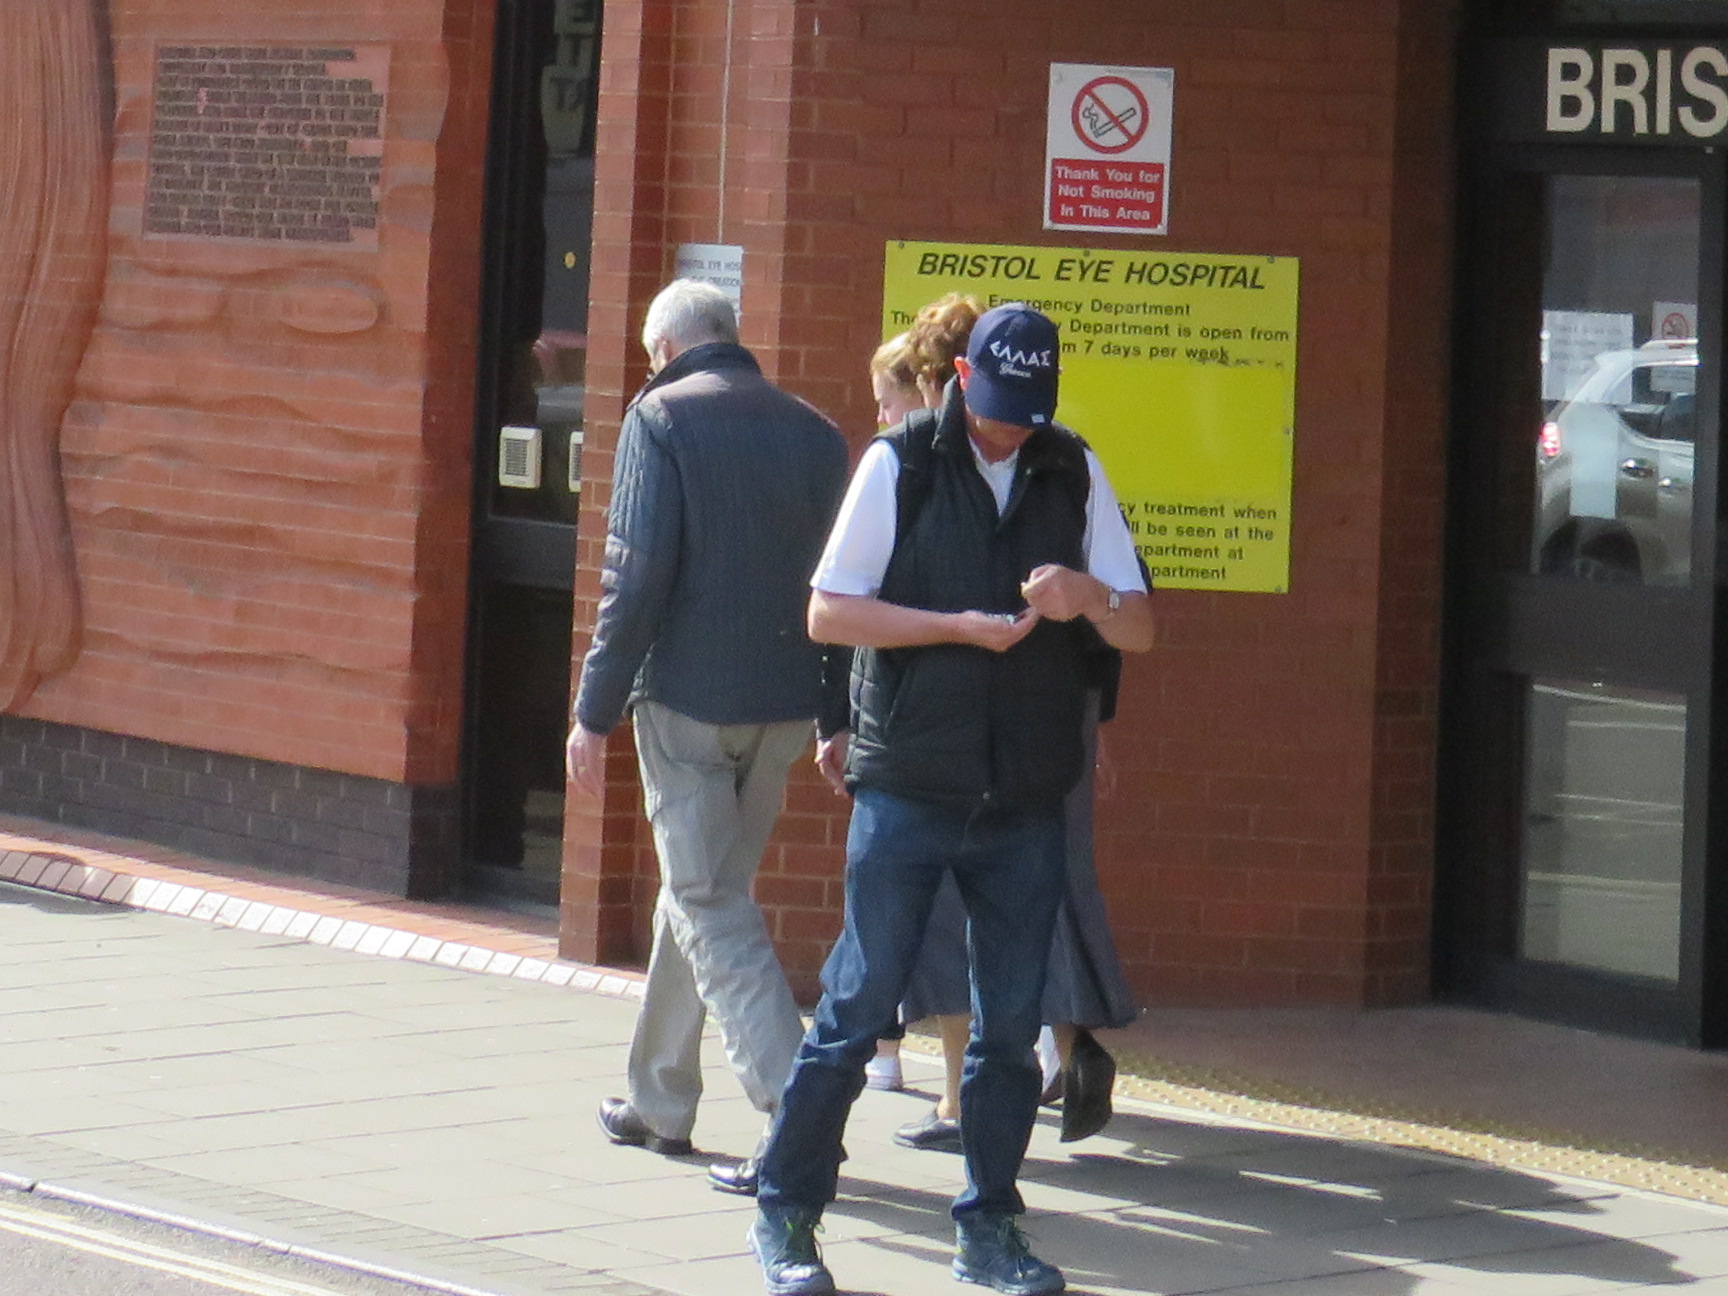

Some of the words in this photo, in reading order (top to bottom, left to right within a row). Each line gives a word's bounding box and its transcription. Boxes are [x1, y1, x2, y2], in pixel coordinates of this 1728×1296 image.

[1055, 166, 1099, 181] Thank
[1106, 168, 1133, 182] You
[1139, 170, 1161, 184] for
[1058, 184, 1084, 198] Not
[1091, 185, 1155, 203] Smoking
[1060, 204, 1073, 217] In
[1080, 204, 1110, 219] This
[1116, 206, 1151, 221] Area
[917, 252, 1041, 281] BRISTOL
[1054, 258, 1114, 283] EYE
[1124, 261, 1265, 290] HOSPITAL
[988, 294, 1083, 314] Emrgency
[1091, 298, 1190, 317] Department
[1070, 319, 1170, 337] Department
[1177, 324, 1192, 338] is
[1200, 327, 1242, 342] open
[1250, 327, 1290, 342] from
[1084, 340, 1094, 353] 7
[1101, 338, 1141, 359] days
[1149, 345, 1177, 362] per
[1186, 347, 1229, 360] week
[1144, 502, 1226, 518] treatment
[1234, 504, 1277, 520] when
[1147, 521, 1168, 535] be
[1176, 525, 1216, 539] seen
[1224, 526, 1239, 539] at
[1248, 526, 1274, 541] the
[1135, 543, 1219, 559] epartment
[1228, 546, 1244, 560] at
[1151, 564, 1226, 580] partment
